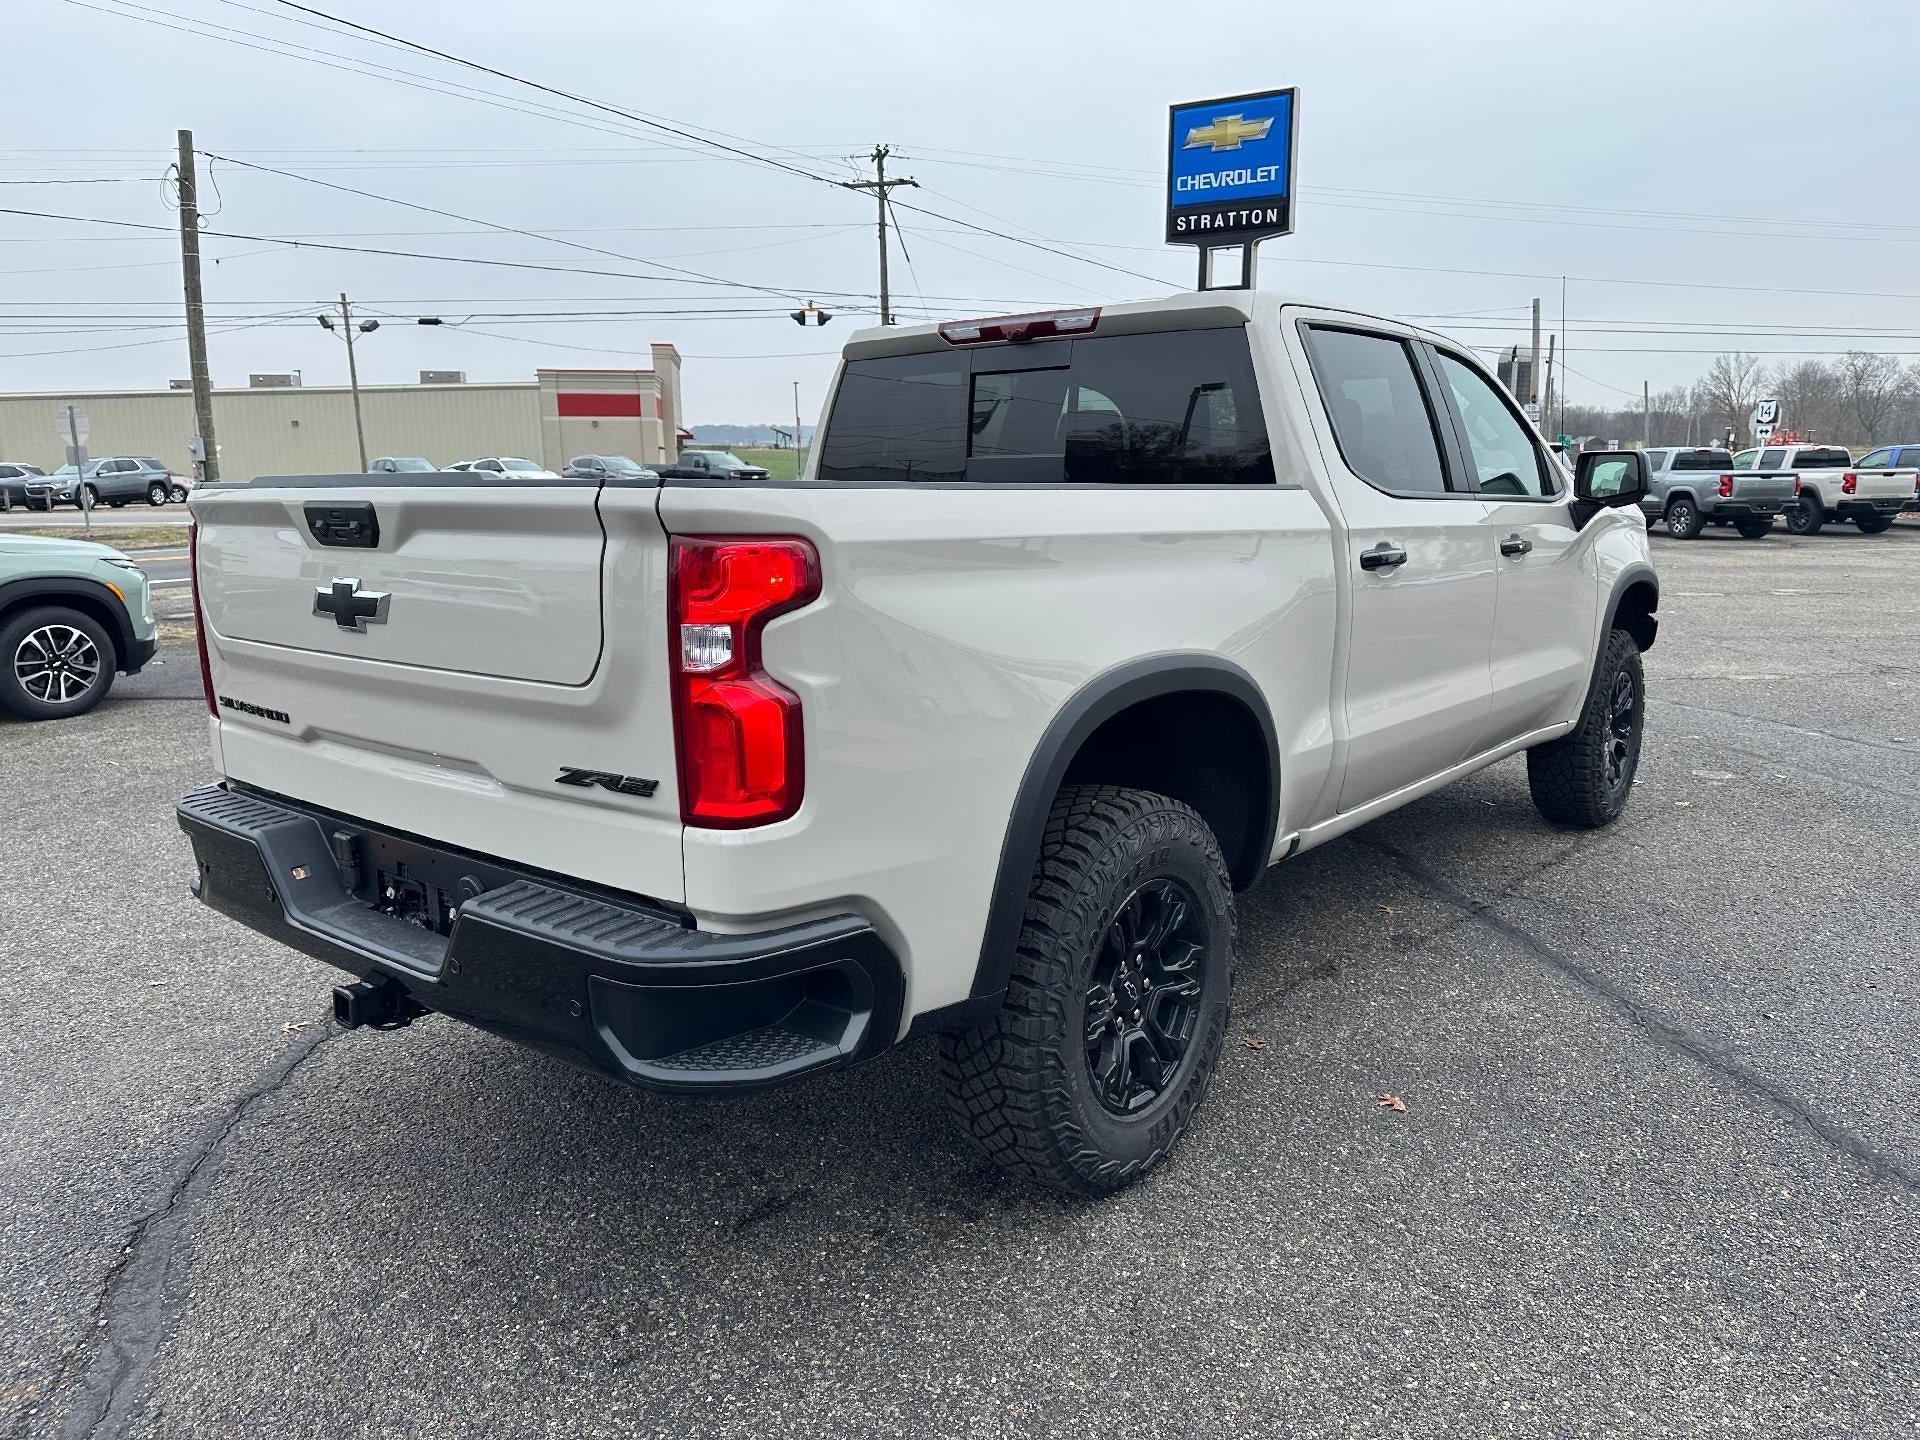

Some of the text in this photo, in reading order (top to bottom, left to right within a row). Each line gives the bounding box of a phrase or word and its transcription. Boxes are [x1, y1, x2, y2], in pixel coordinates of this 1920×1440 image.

[1177, 165, 1280, 192] CHEVROLET
[1176, 208, 1278, 231] STRATTON
[1760, 405, 1772, 418] 14
[219, 695, 290, 724] SILVERADO
[555, 766, 660, 798] ZR2
